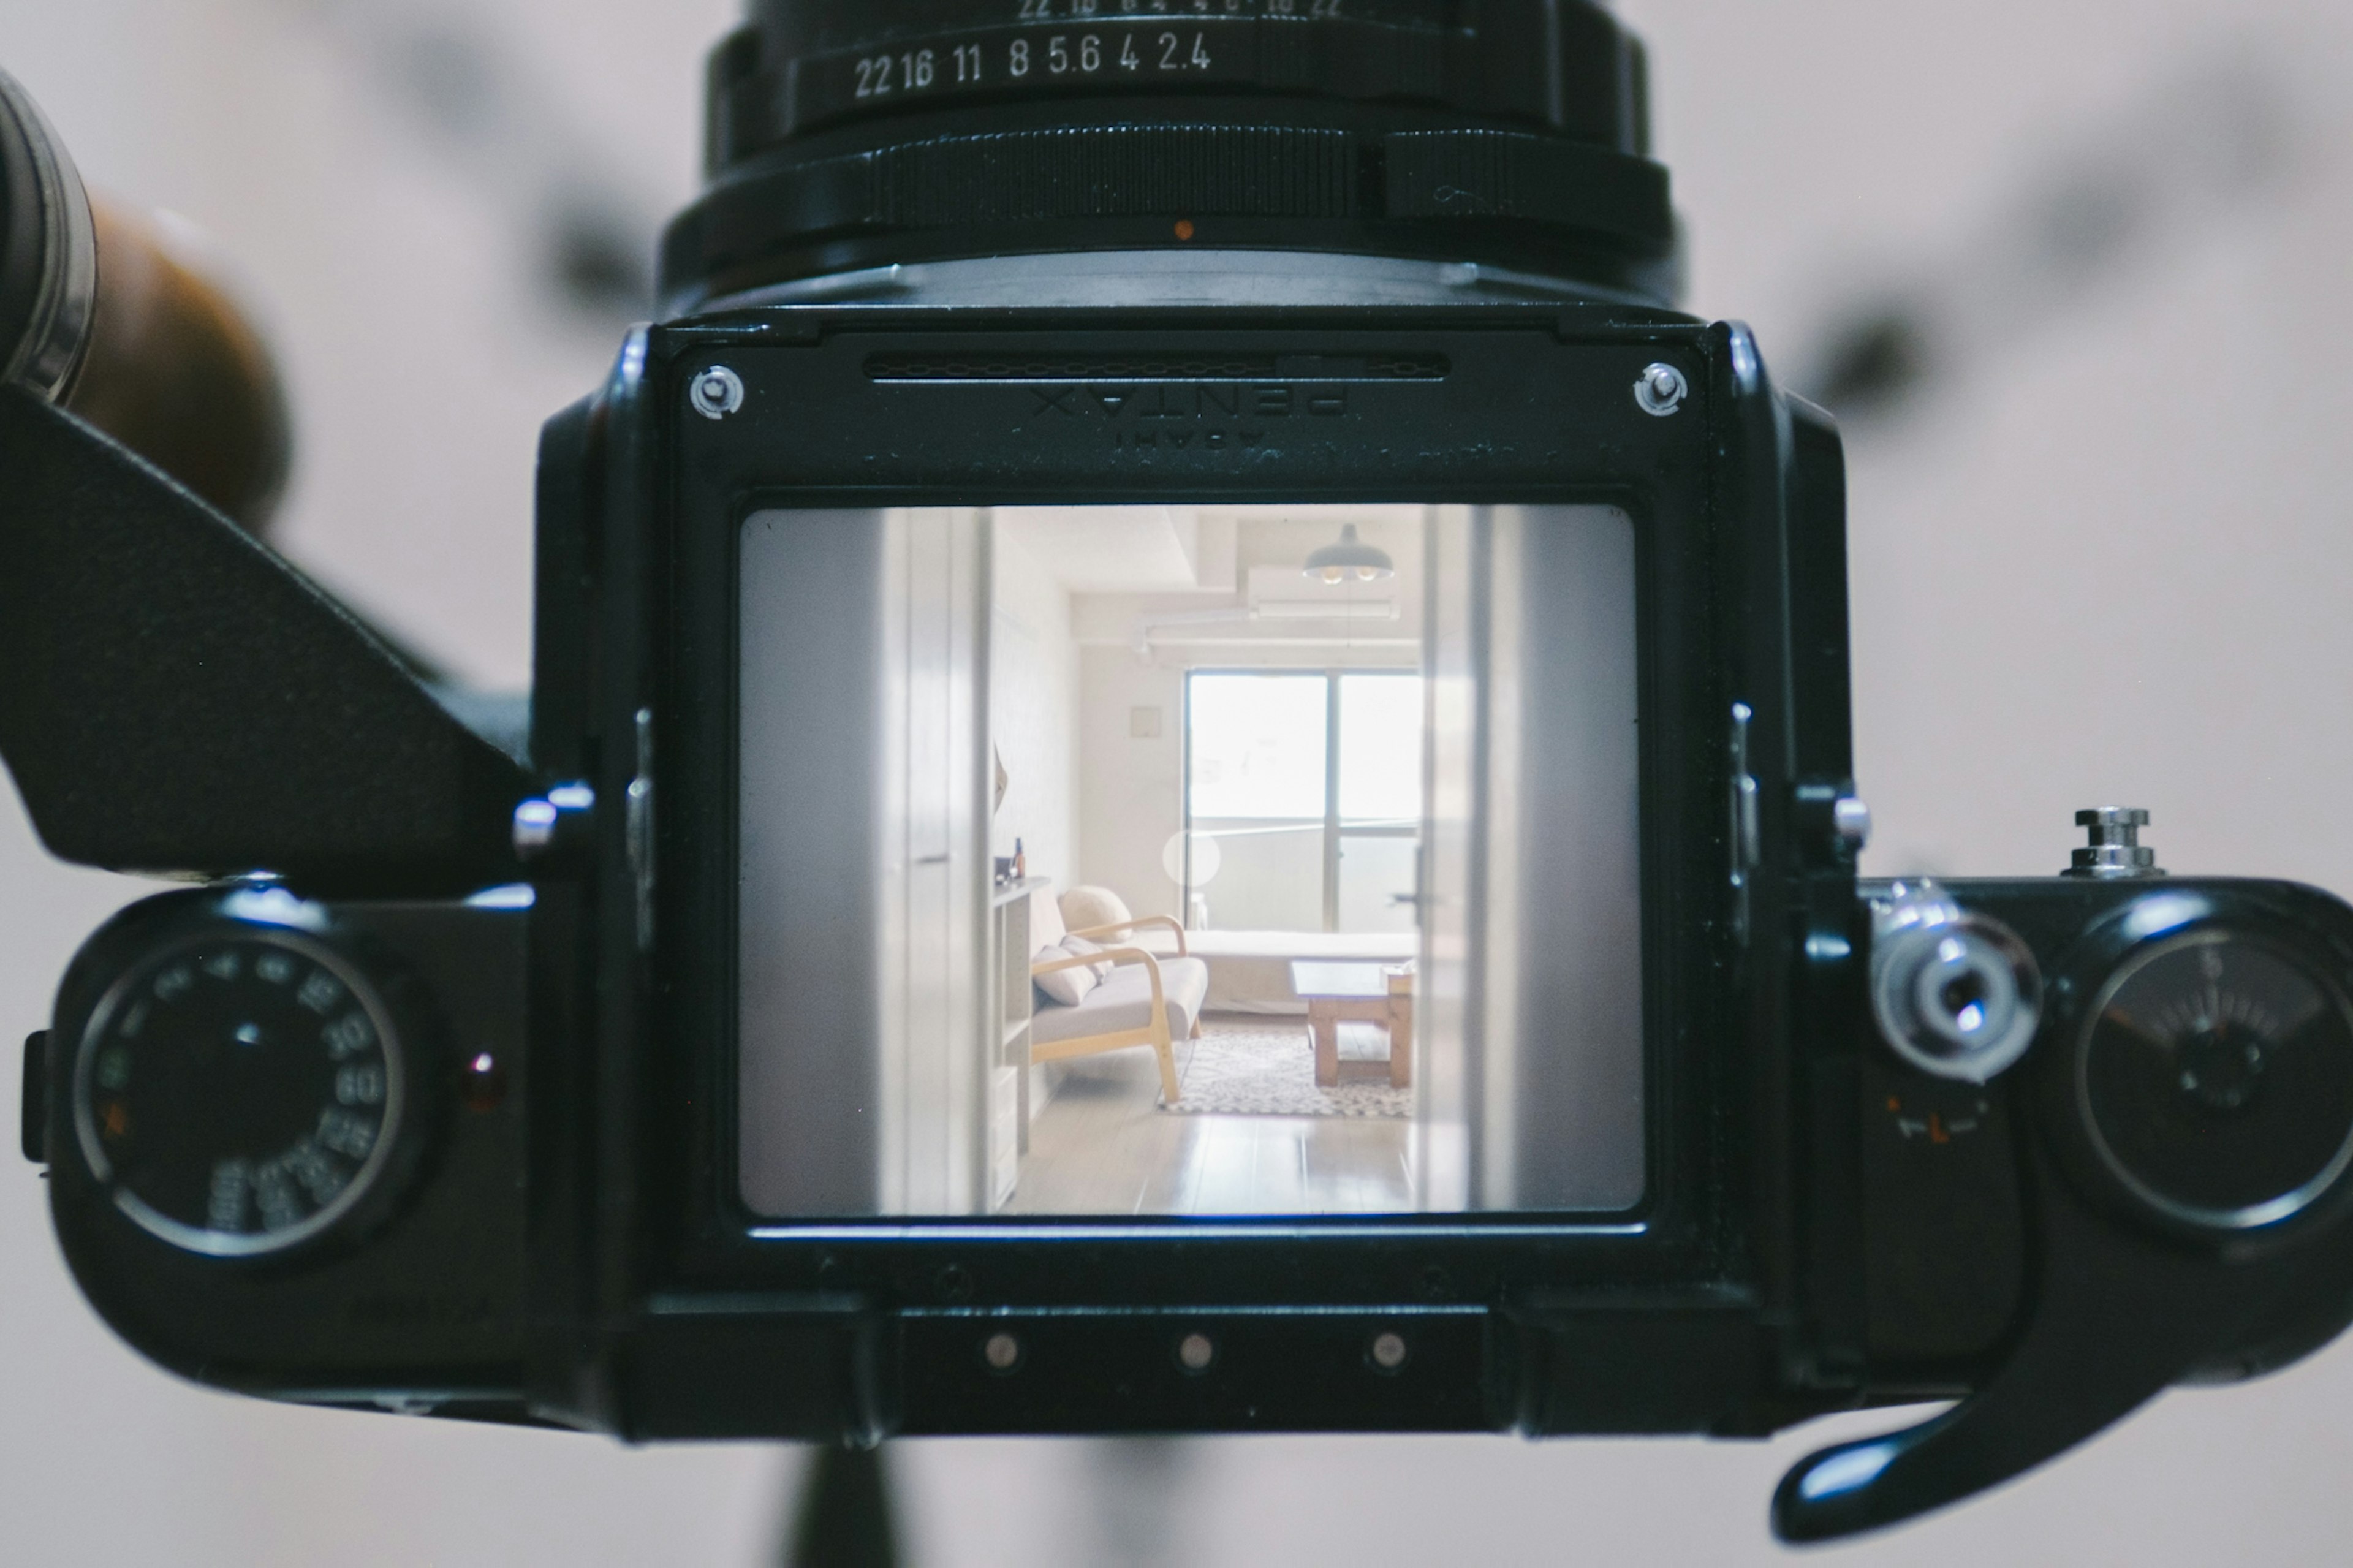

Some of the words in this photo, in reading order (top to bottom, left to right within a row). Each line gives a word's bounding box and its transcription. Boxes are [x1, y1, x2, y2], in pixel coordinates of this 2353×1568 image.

[855, 55, 891, 97] 22
[901, 49, 934, 87] 16
[953, 44, 980, 81] 11
[1010, 39, 1028, 76] 8
[1049, 34, 1101, 73] 5.6
[1120, 34, 1139, 70] 4
[1159, 32, 1211, 69] 2.4
[1030, 386, 1347, 417] PENTAX
[336, 1067, 383, 1104] 60
